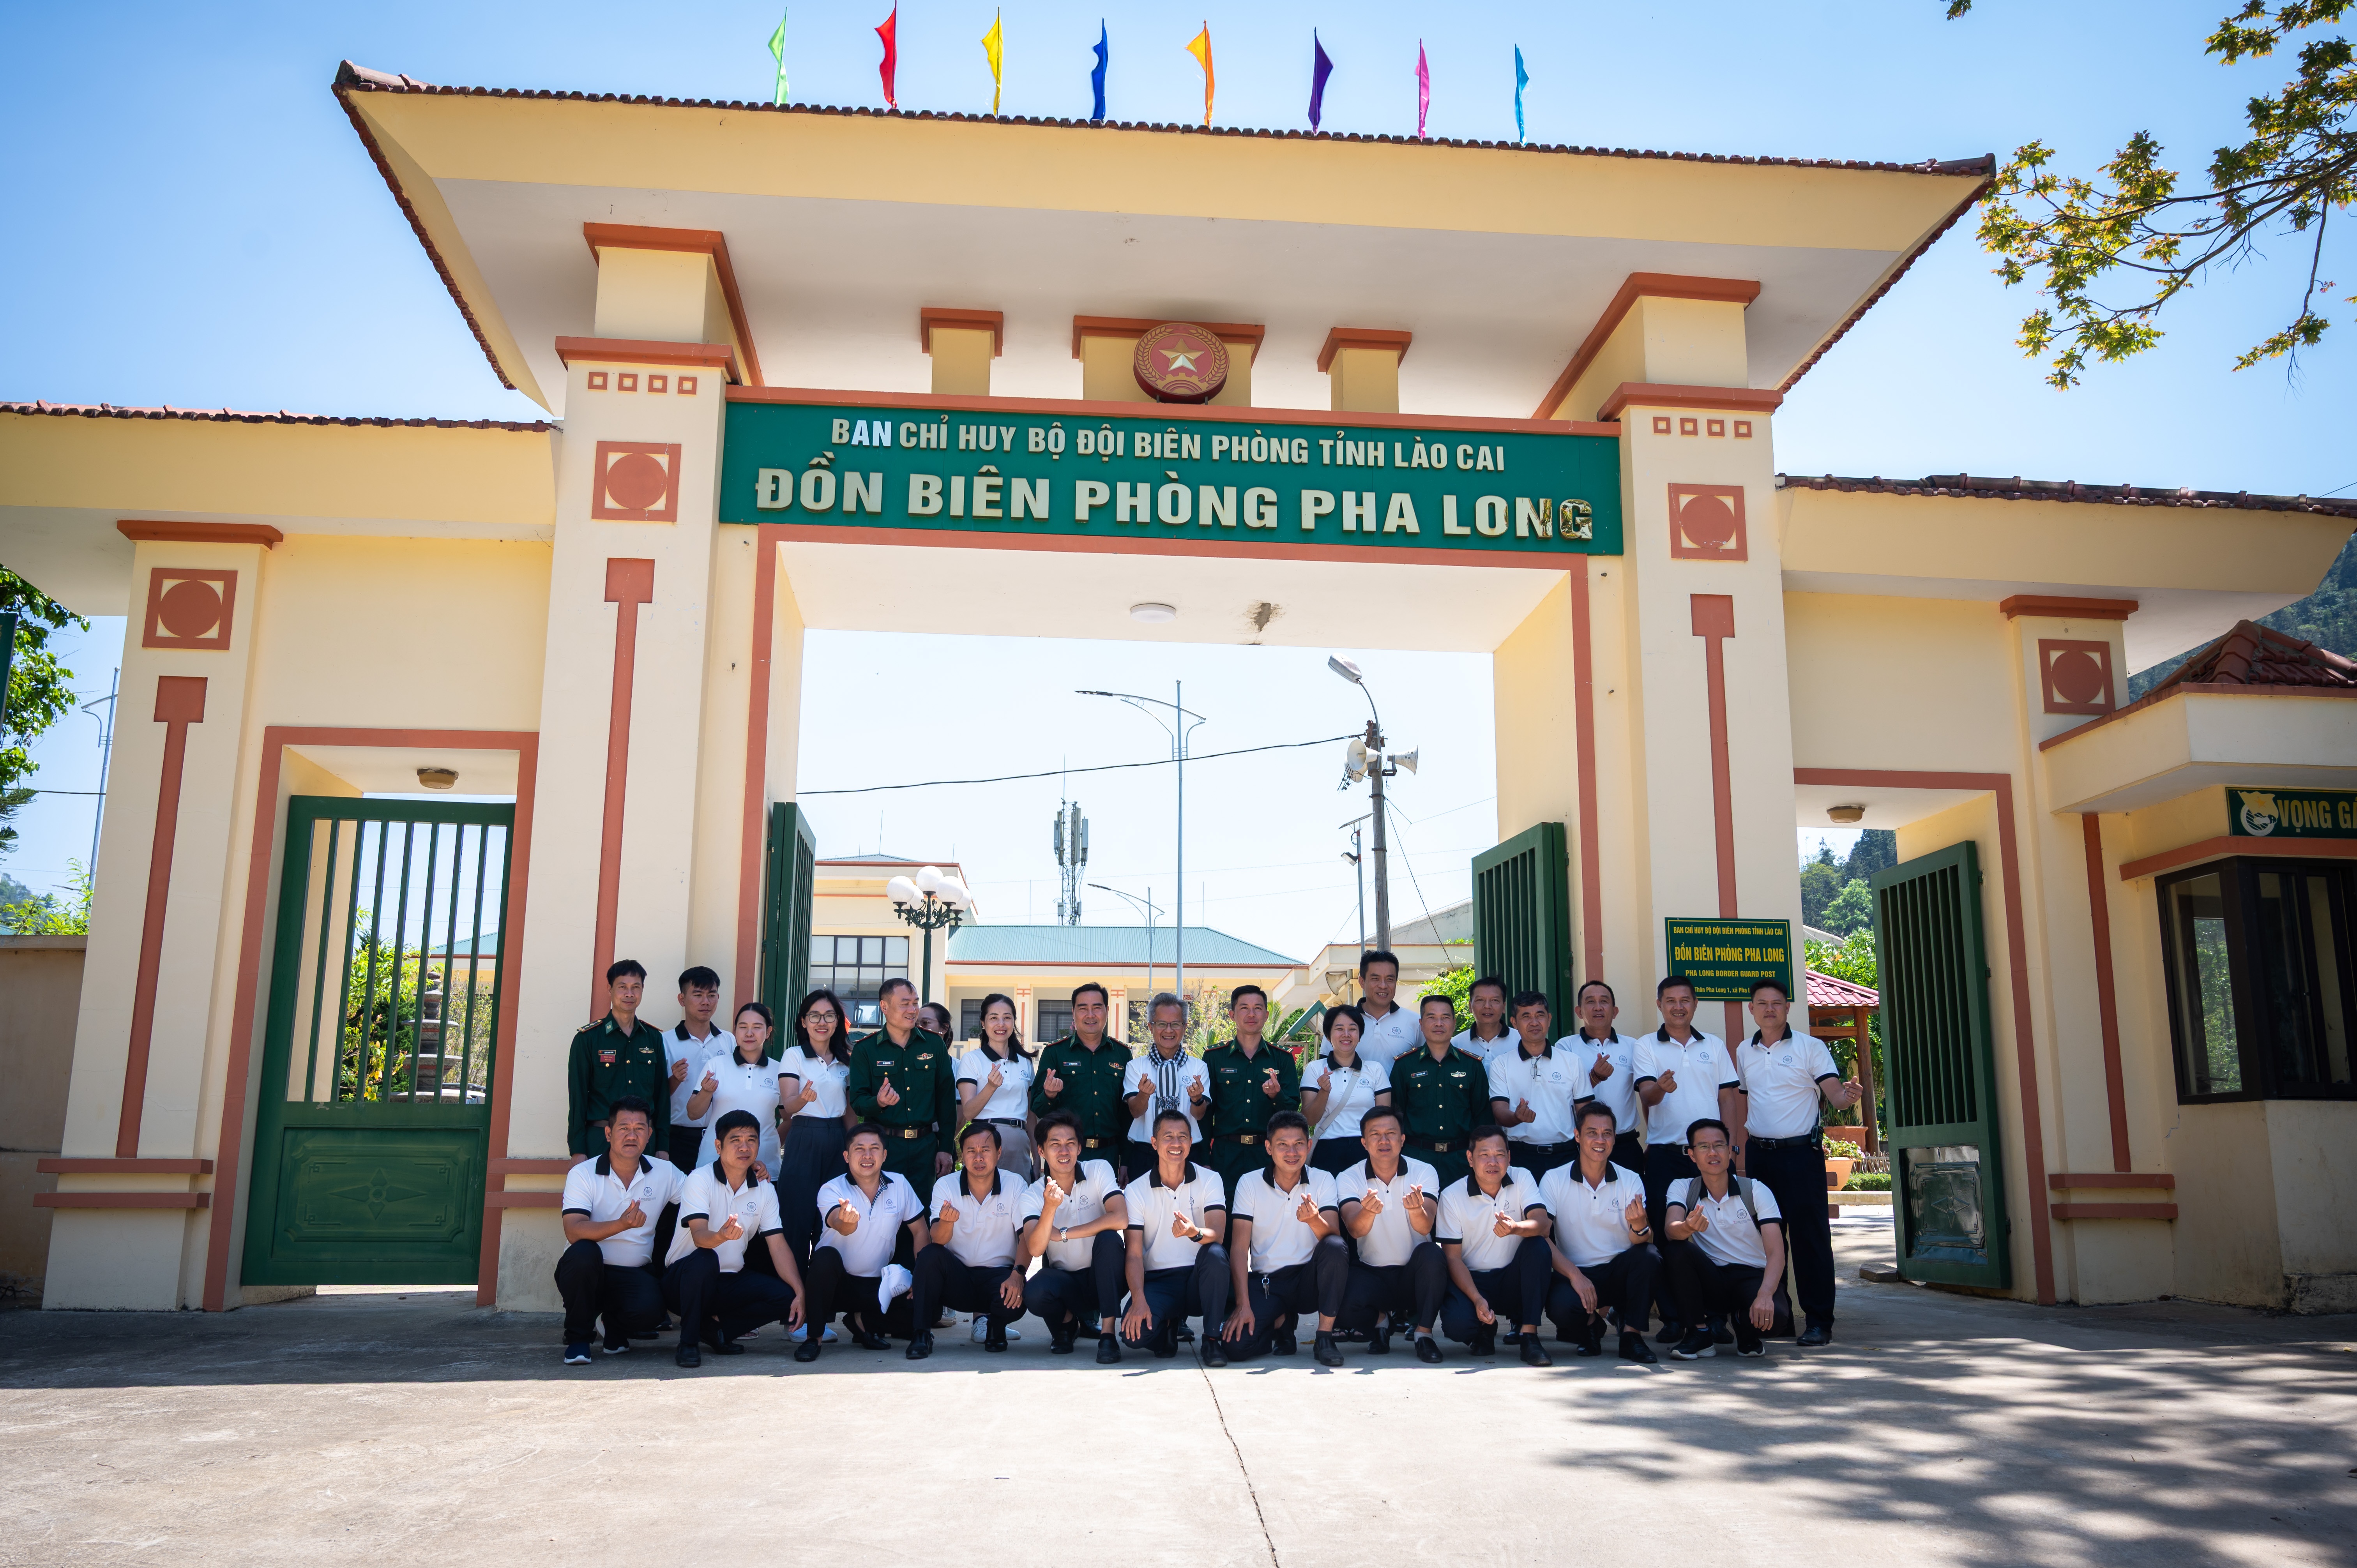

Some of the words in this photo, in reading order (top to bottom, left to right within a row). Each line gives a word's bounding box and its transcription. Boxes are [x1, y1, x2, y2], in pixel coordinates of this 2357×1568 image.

[832, 418, 892, 447] BAN
[899, 414, 949, 450] CHỈ
[959, 425, 1016, 452] HUY
[1028, 422, 1065, 460] BỘ
[1076, 424, 1124, 463] ĐỘI
[1134, 427, 1201, 460] BIÊN
[1212, 429, 1308, 464] PHÒNG
[1319, 430, 1384, 467] TỈNH
[1394, 436, 1448, 469] LÀO
[1456, 444, 1504, 471] CAI
[755, 451, 883, 515] ĐỒN
[908, 465, 1050, 521] BIÊN
[1075, 471, 1277, 529] PHÒNG
[1300, 489, 1421, 534] PHA
[1443, 494, 1593, 541] LONG
[2277, 800, 2332, 833] VỌNG
[1685, 925, 1693, 934] CHỈ
[1705, 925, 1712, 936] BỘ
[1712, 926, 1721, 936] ĐỘI
[1722, 926, 1734, 934] BIÊN
[1735, 926, 1751, 935] PHÒNG
[1752, 926, 1763, 935] TỈNH
[1764, 927, 1774, 935] LÀO
[1675, 942, 1692, 961] ĐỒN
[1694, 944, 1713, 961] BIÊN
[1715, 944, 1743, 961] PHÒNG
[1745, 948, 1762, 962] PHA
[1763, 948, 1785, 962] LONG
